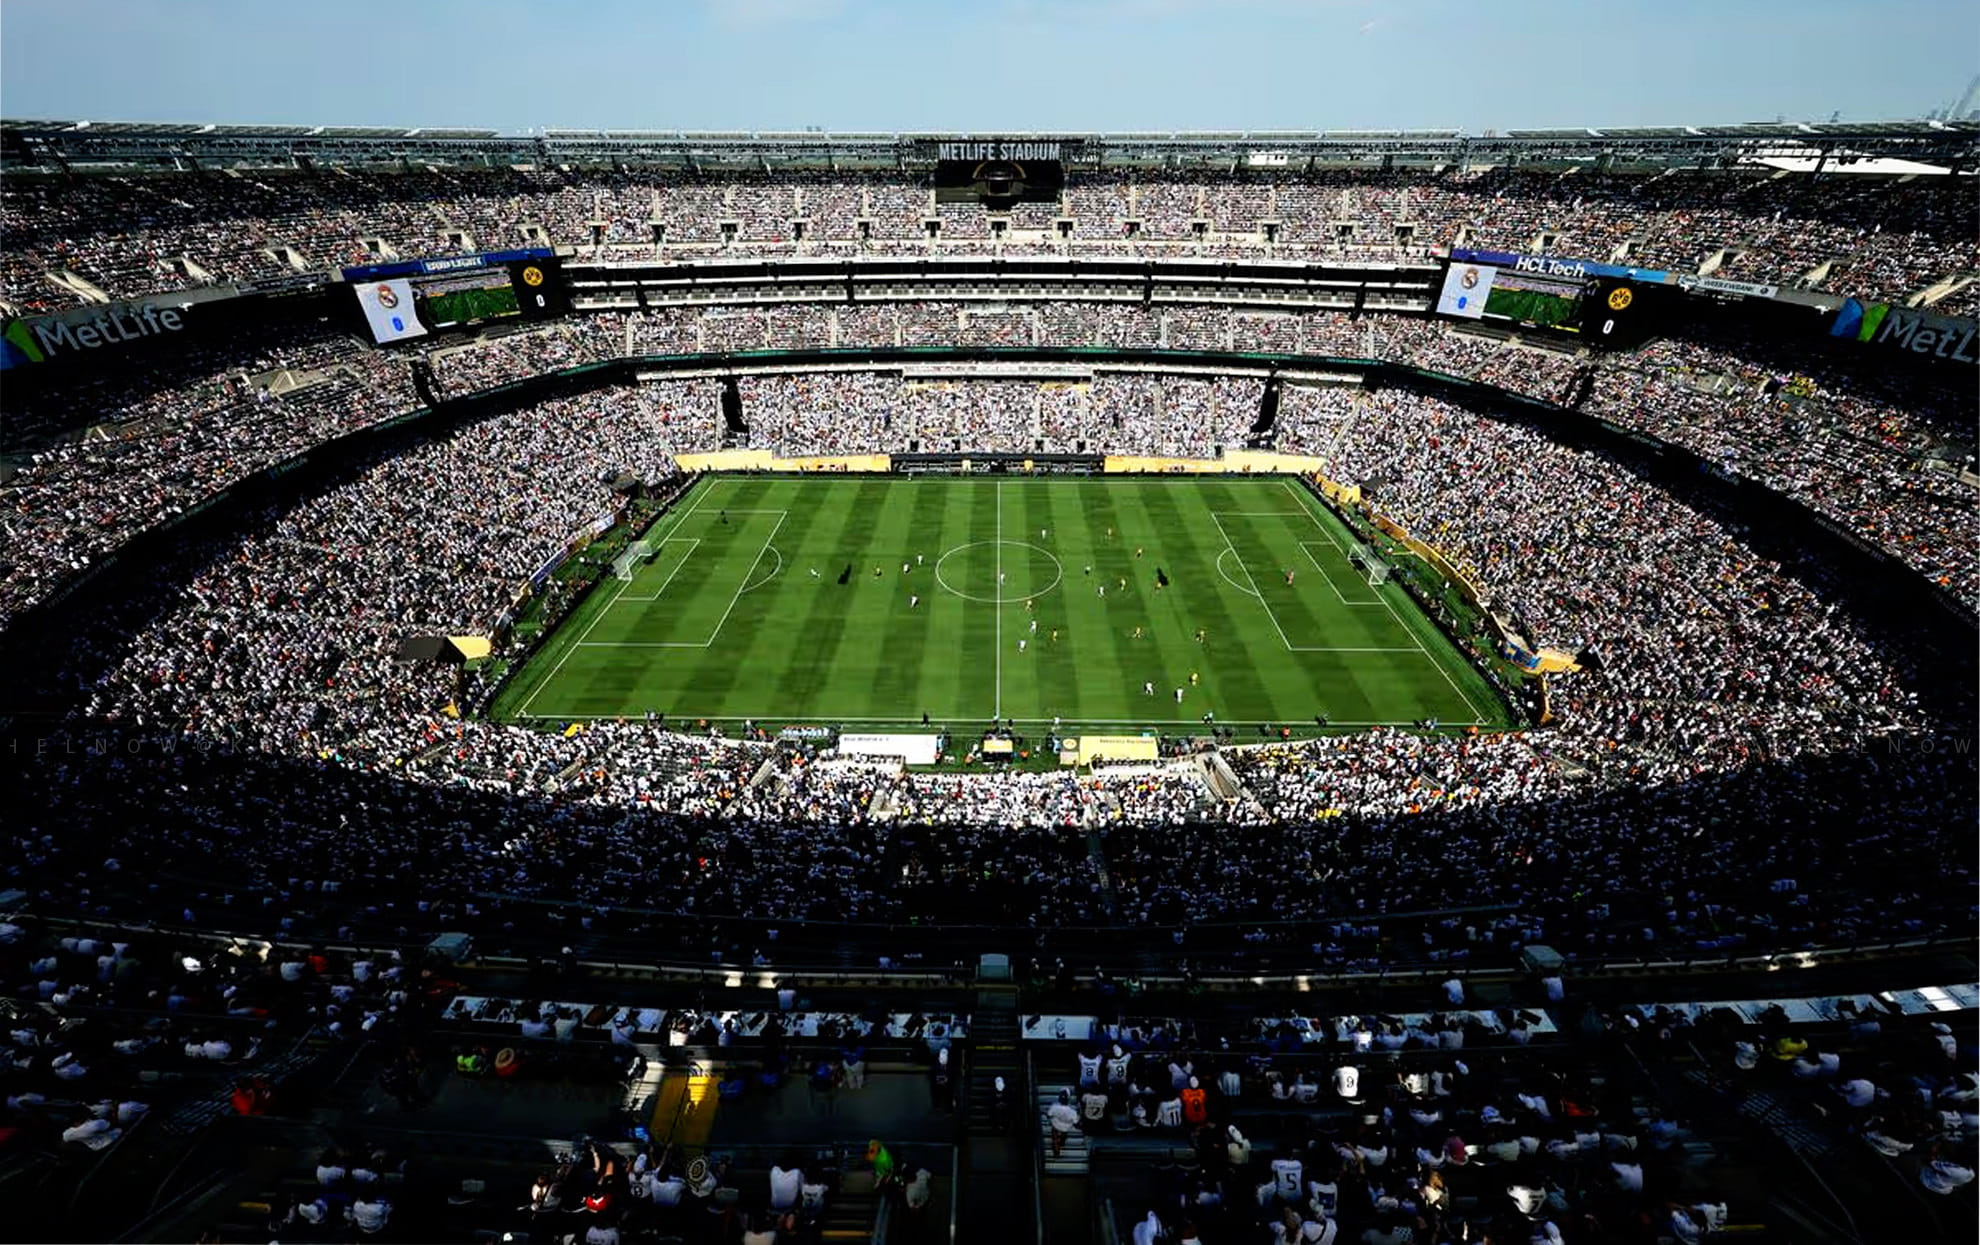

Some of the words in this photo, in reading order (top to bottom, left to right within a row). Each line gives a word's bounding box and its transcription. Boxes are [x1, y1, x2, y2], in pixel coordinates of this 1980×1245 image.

[939, 143, 996, 161] METLIFE
[1000, 143, 1060, 161] STADIUM
[1516, 256, 1585, 278] HCLTech
[536, 294, 545, 307] 0
[34, 303, 184, 356] MetLife
[1602, 319, 1614, 335] 0
[1878, 308, 1979, 366] MetL
[1346, 1076, 1355, 1089] 9
[1286, 1173, 1297, 1191] 5
